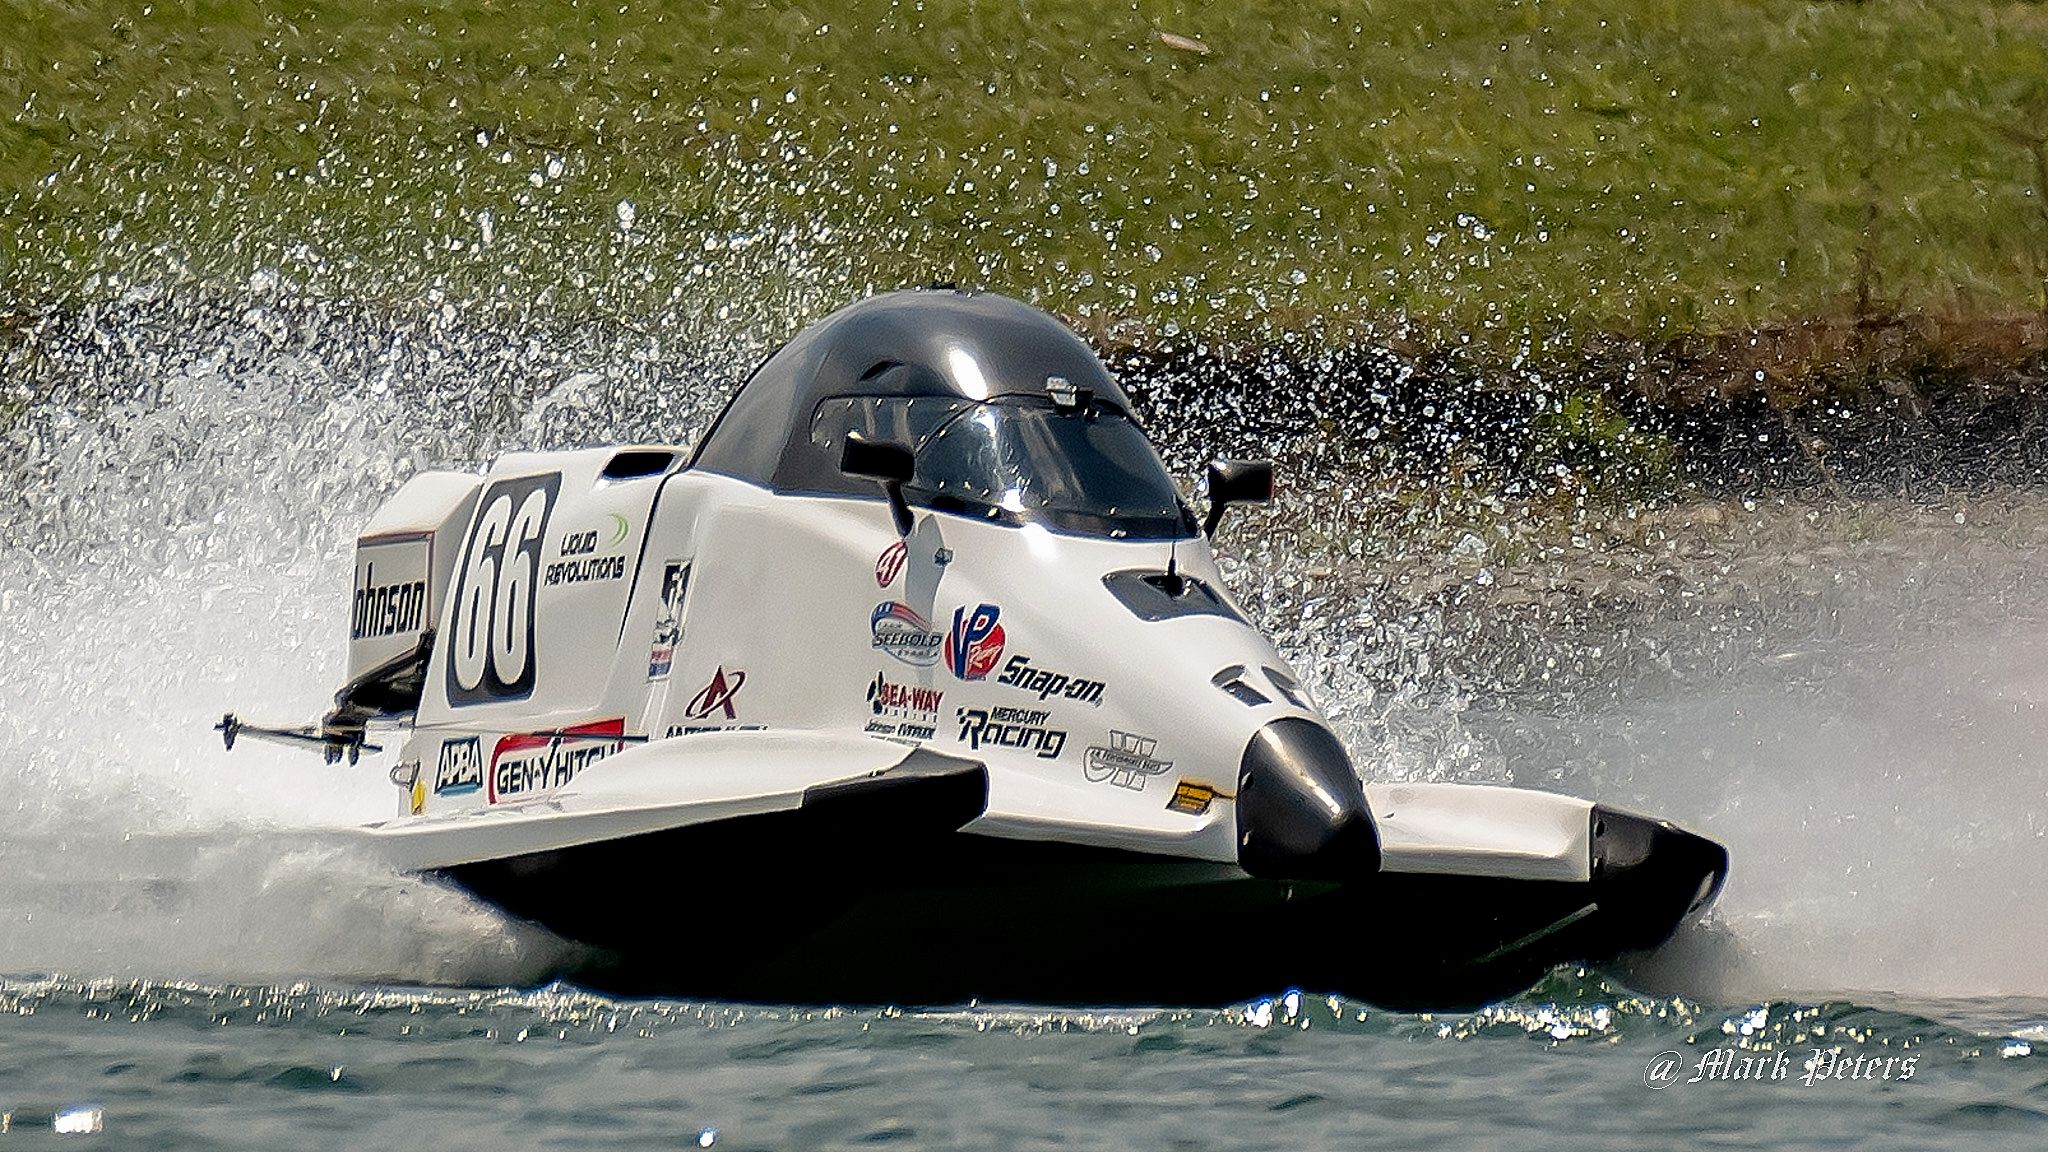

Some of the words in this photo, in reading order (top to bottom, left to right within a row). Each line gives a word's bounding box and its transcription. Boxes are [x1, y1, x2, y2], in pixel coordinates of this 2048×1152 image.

[561, 530, 598, 556] LIQUID
[455, 488, 547, 690] 66
[545, 556, 626, 586] REVOLUTIONS
[952, 603, 1001, 679] VP
[997, 654, 1107, 702] Snap-on
[956, 706, 1067, 759] Racing
[991, 705, 1051, 725] MERCURY
[437, 741, 480, 788] APBA
